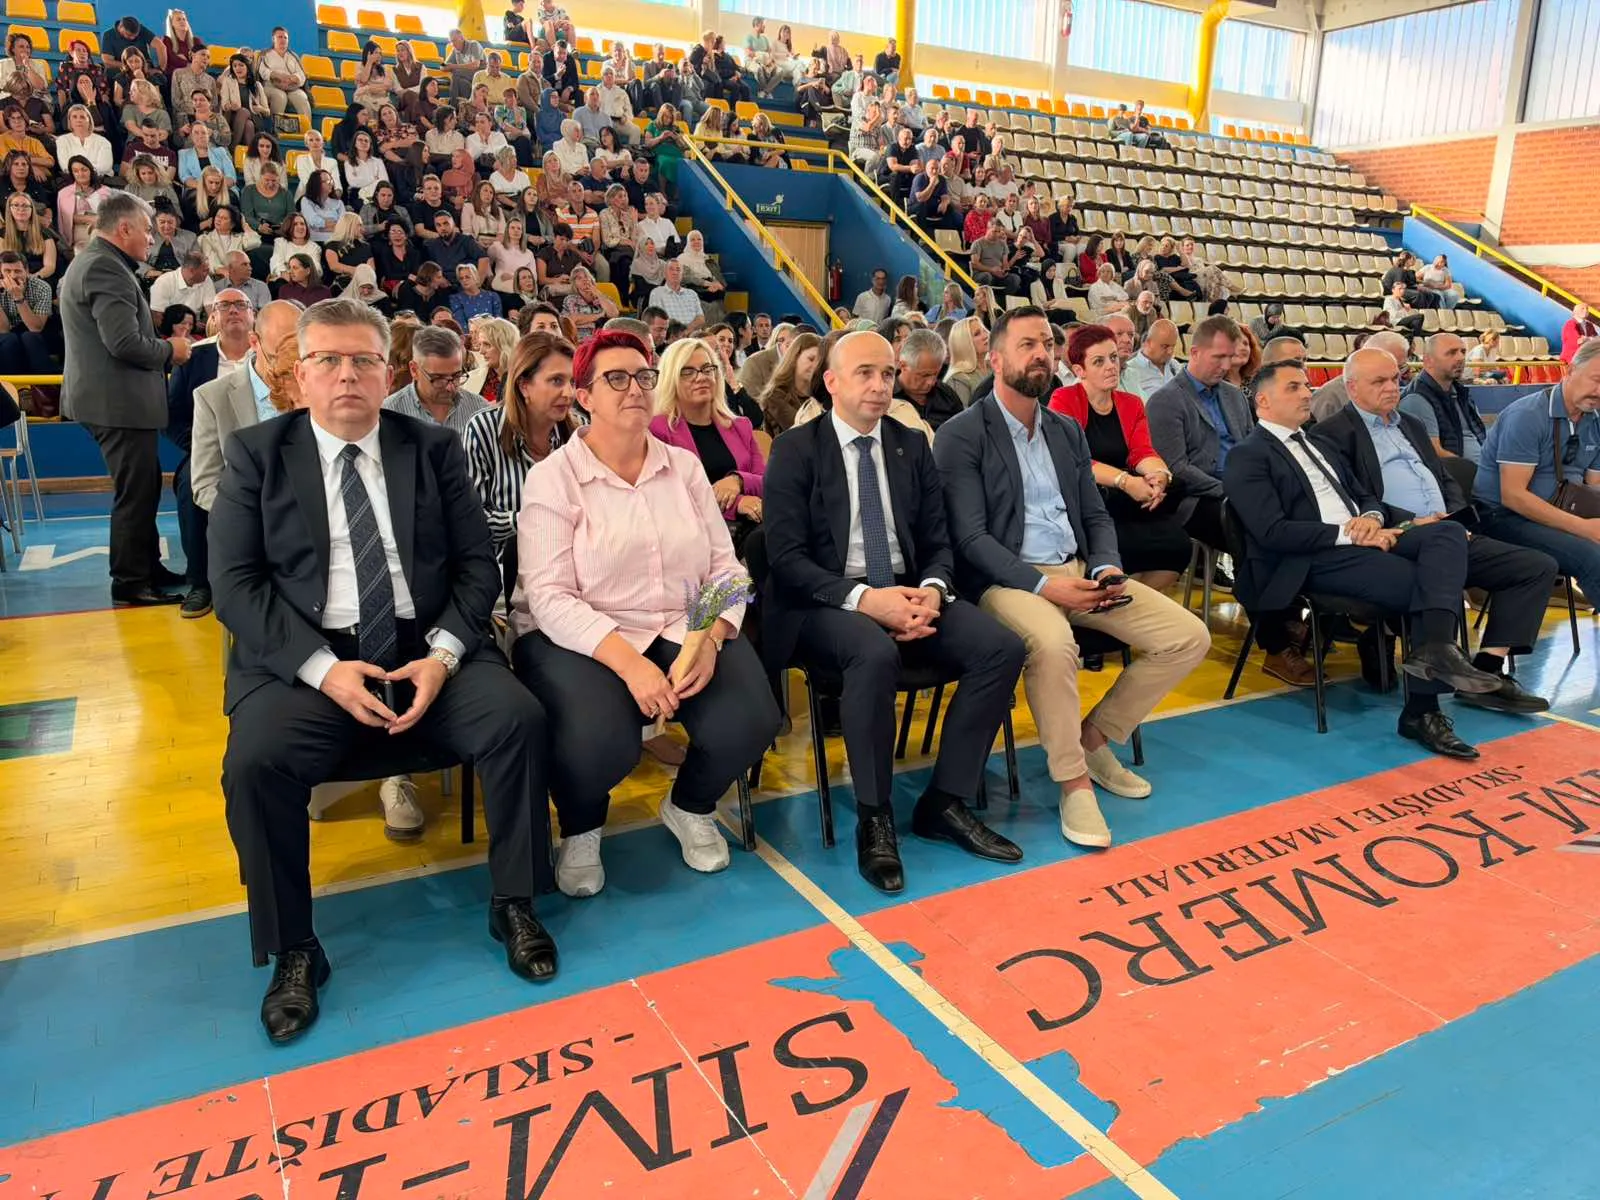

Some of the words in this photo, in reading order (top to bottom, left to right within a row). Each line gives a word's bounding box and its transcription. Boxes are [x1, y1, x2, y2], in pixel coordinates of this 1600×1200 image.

[996, 769, 1600, 1032] M-KOMERC
[1100, 823, 1341, 906] MATERIJALI
[146, 1036, 594, 1200] SKLADIŠTE
